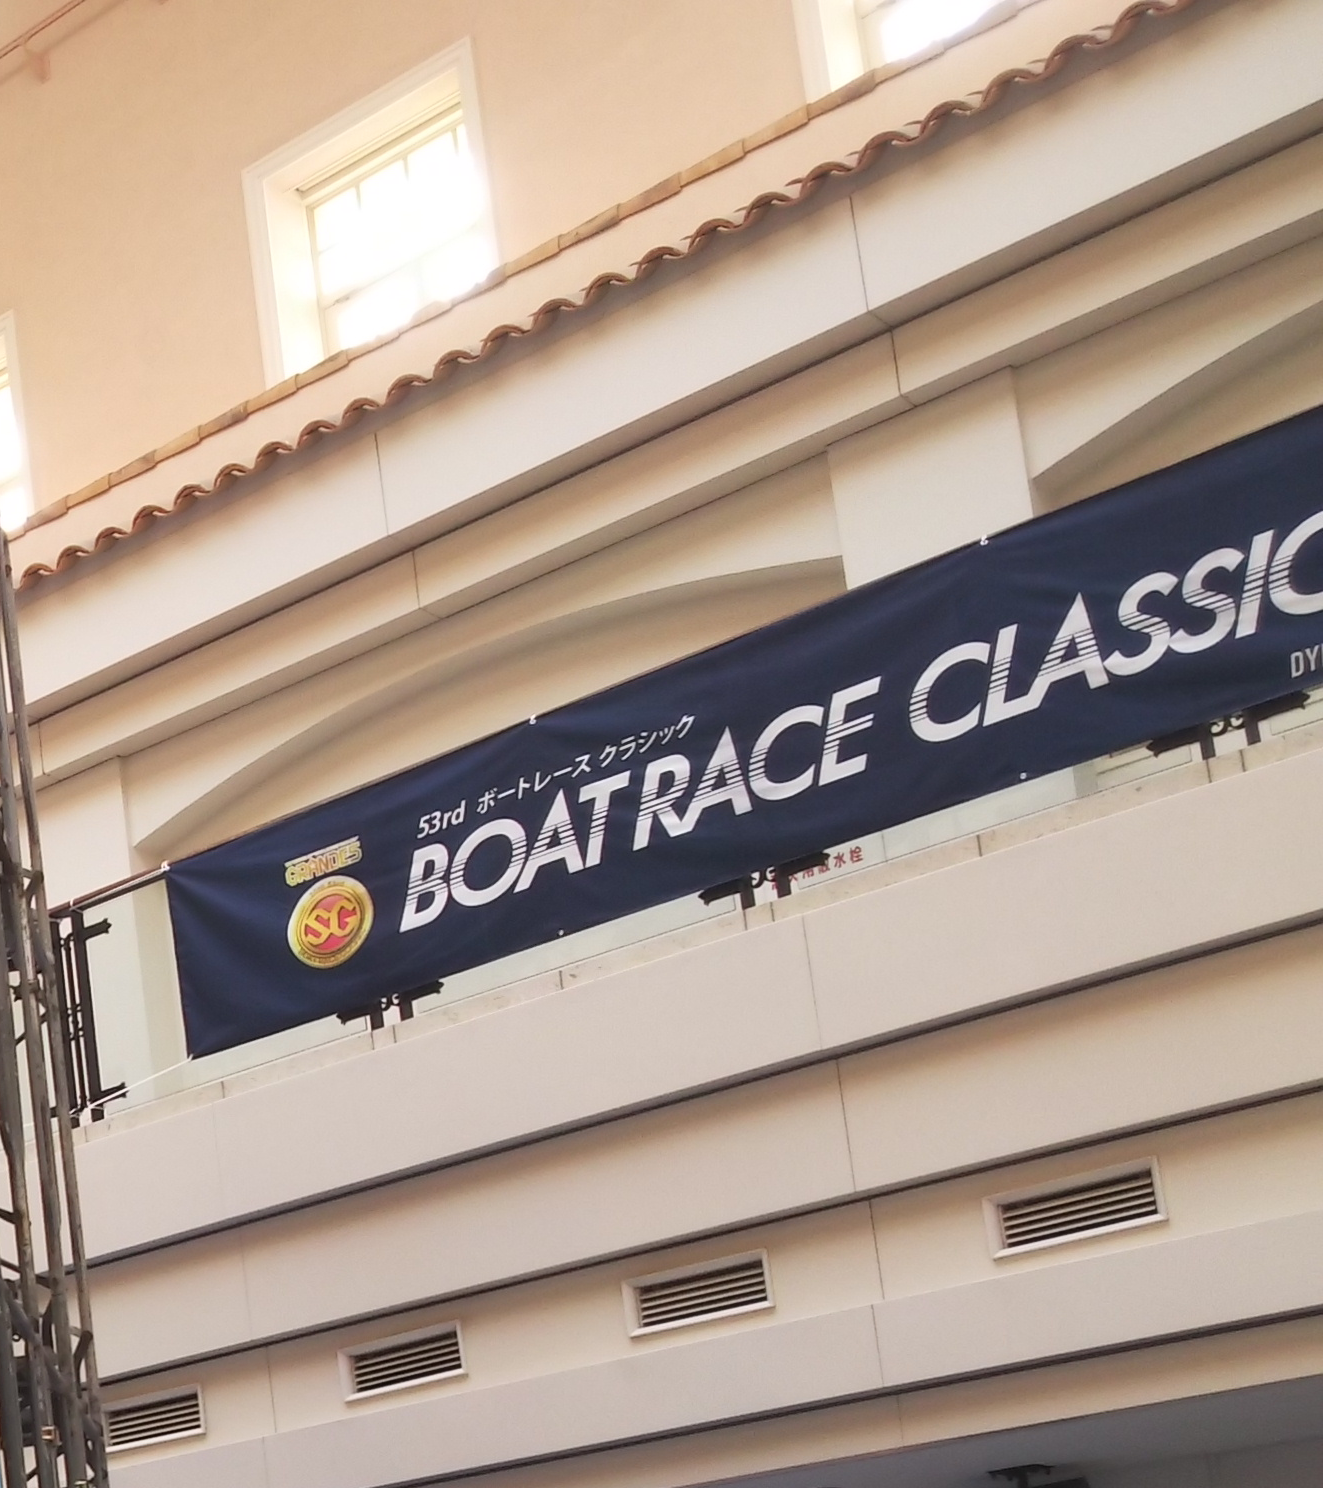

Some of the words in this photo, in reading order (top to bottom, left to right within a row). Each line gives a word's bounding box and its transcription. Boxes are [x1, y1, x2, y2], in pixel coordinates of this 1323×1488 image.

[417, 802, 466, 839] 53rd
[477, 753, 592, 815] ボートレース
[599, 714, 696, 768] クラシック
